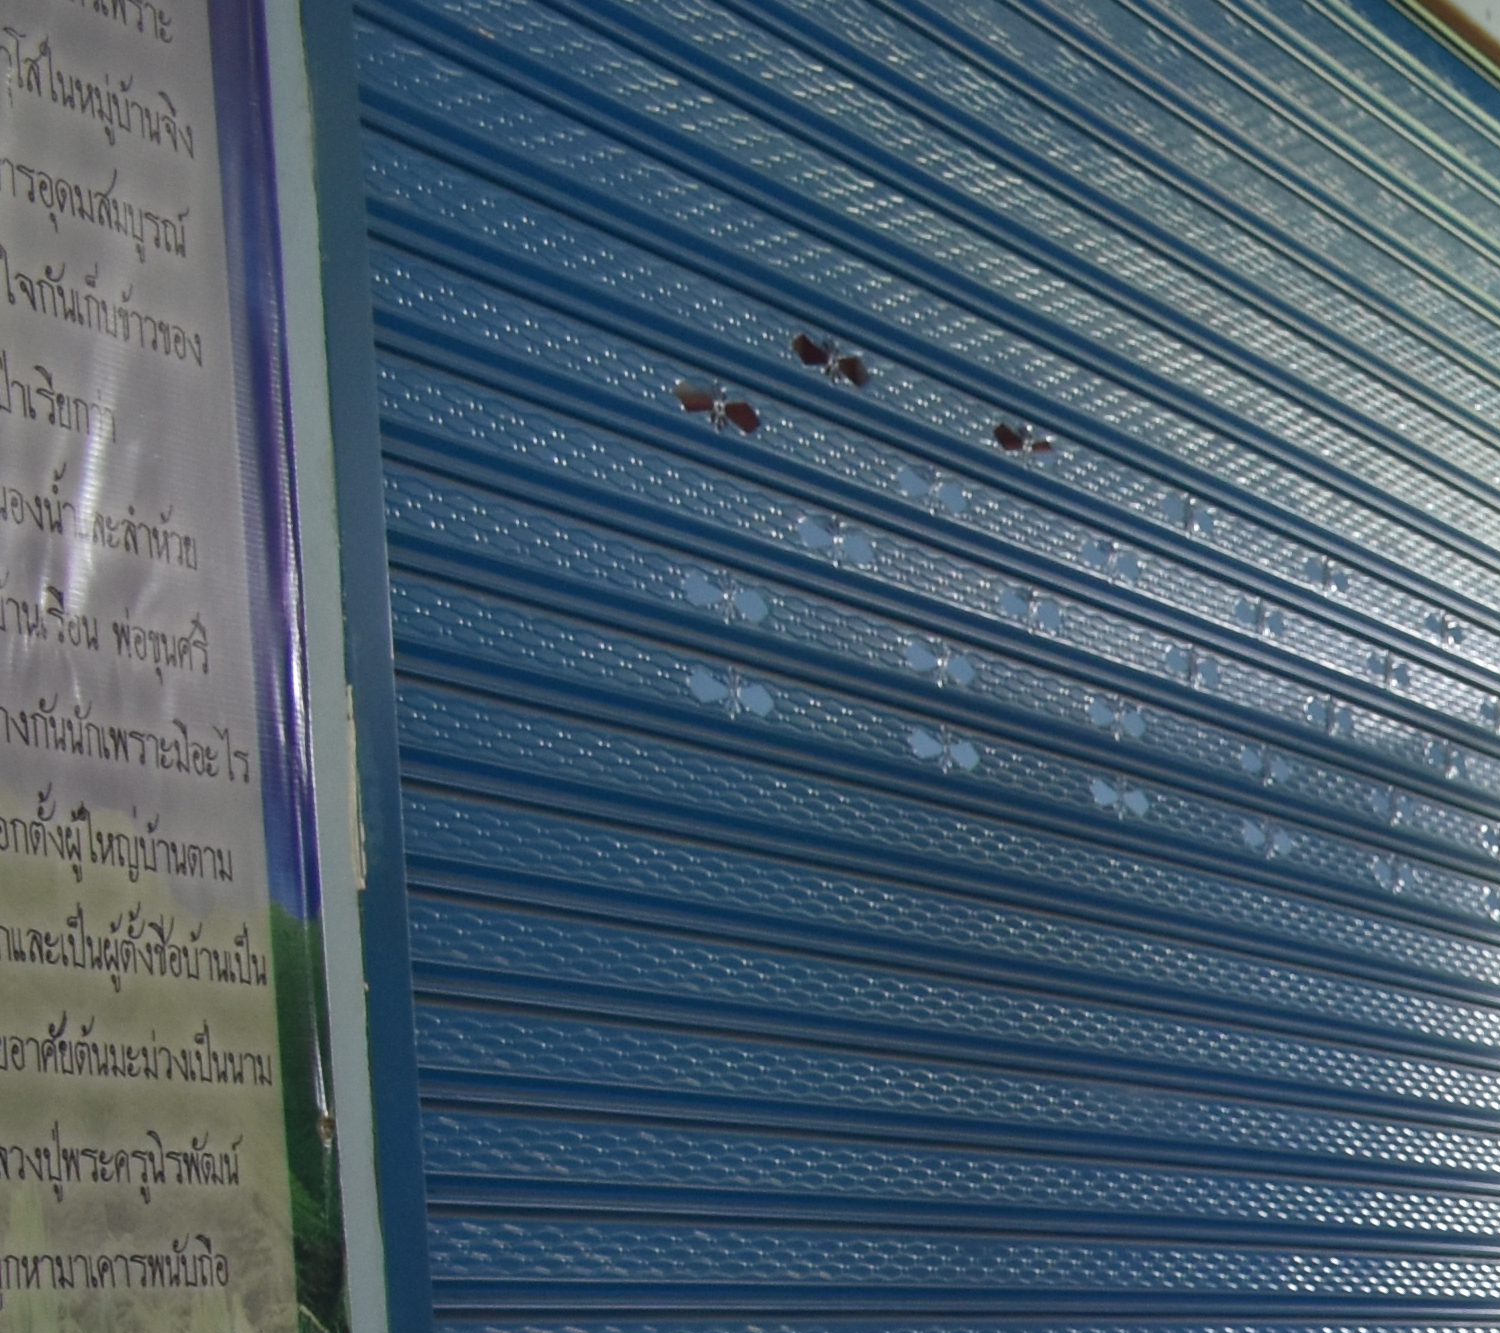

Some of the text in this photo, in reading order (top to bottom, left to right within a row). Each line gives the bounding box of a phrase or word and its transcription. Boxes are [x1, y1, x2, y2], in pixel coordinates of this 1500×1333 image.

[0, 1232, 229, 1305] กหามาเคารพนับถือ
